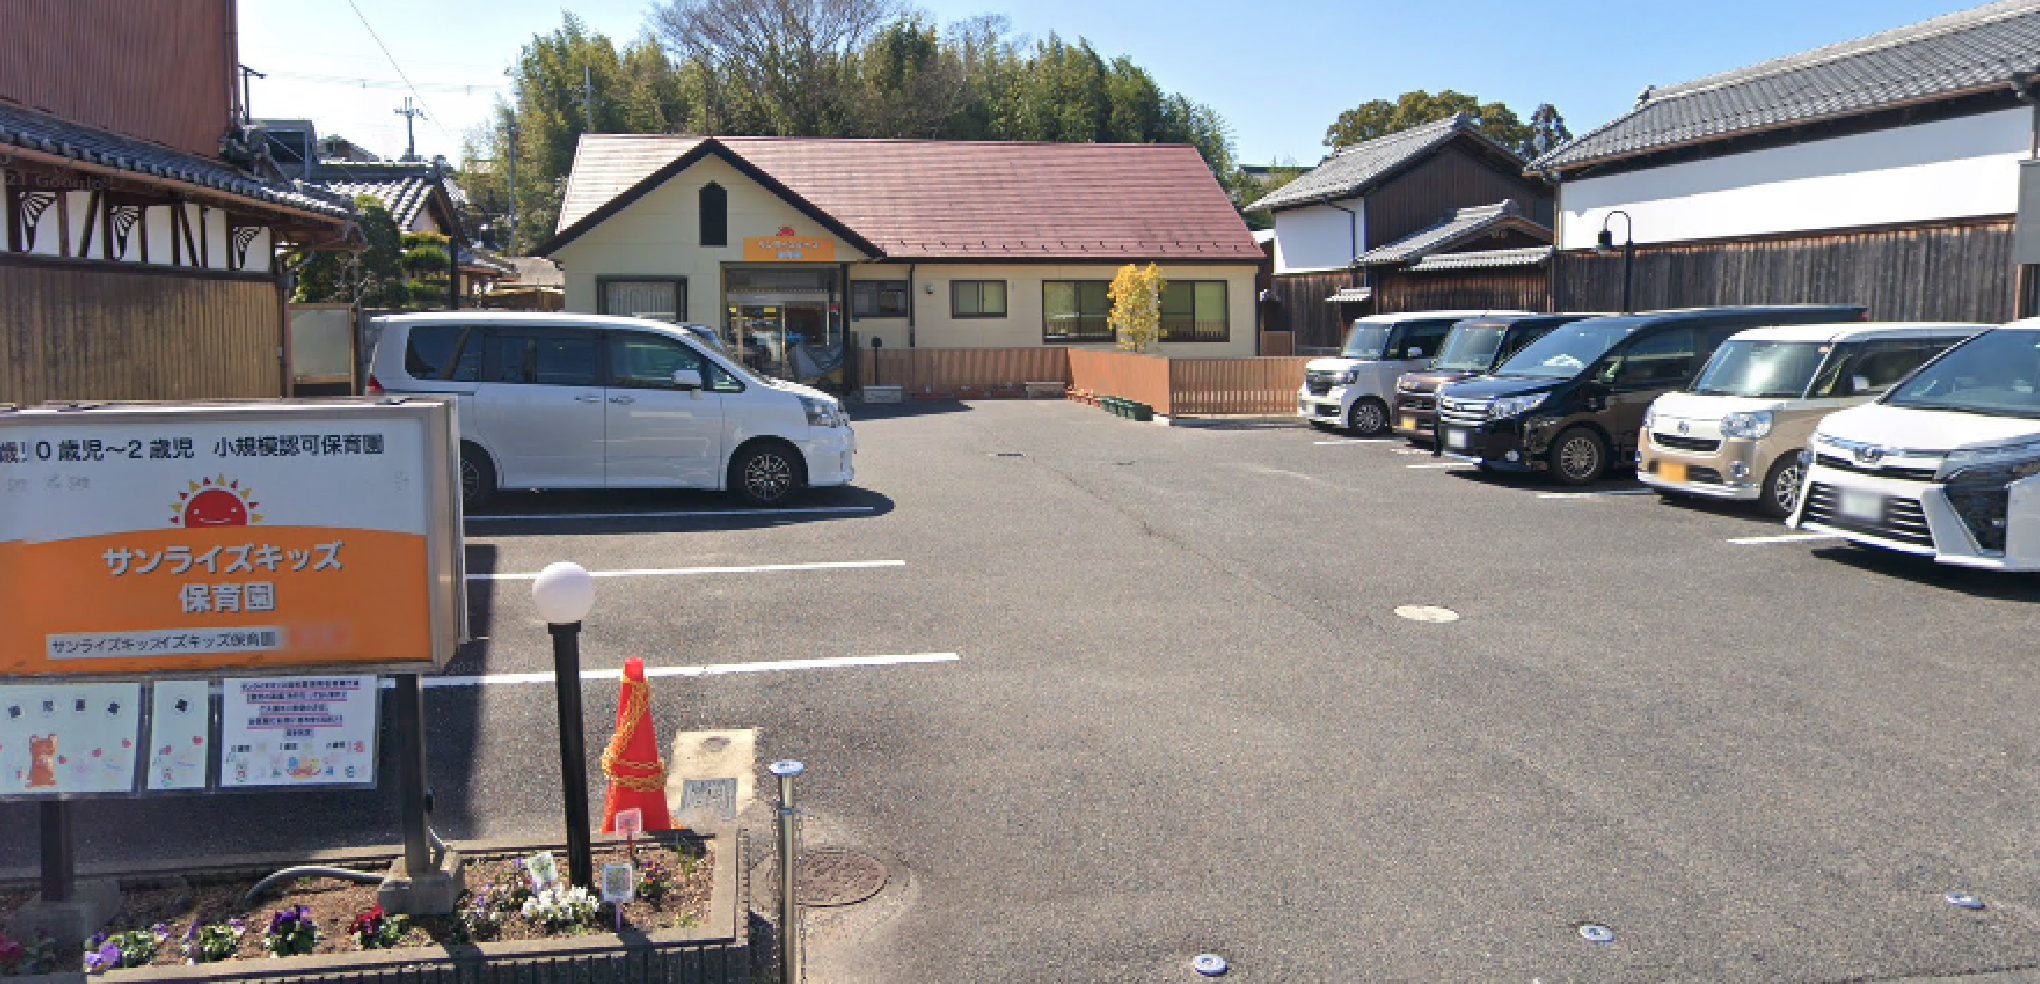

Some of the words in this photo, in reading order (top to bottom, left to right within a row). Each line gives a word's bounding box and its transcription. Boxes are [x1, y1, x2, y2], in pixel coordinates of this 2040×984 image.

[212, 434, 385, 459] 小規模認可保育園
[102, 540, 345, 576] サンライズキッズ
[178, 581, 276, 613] 保育園
